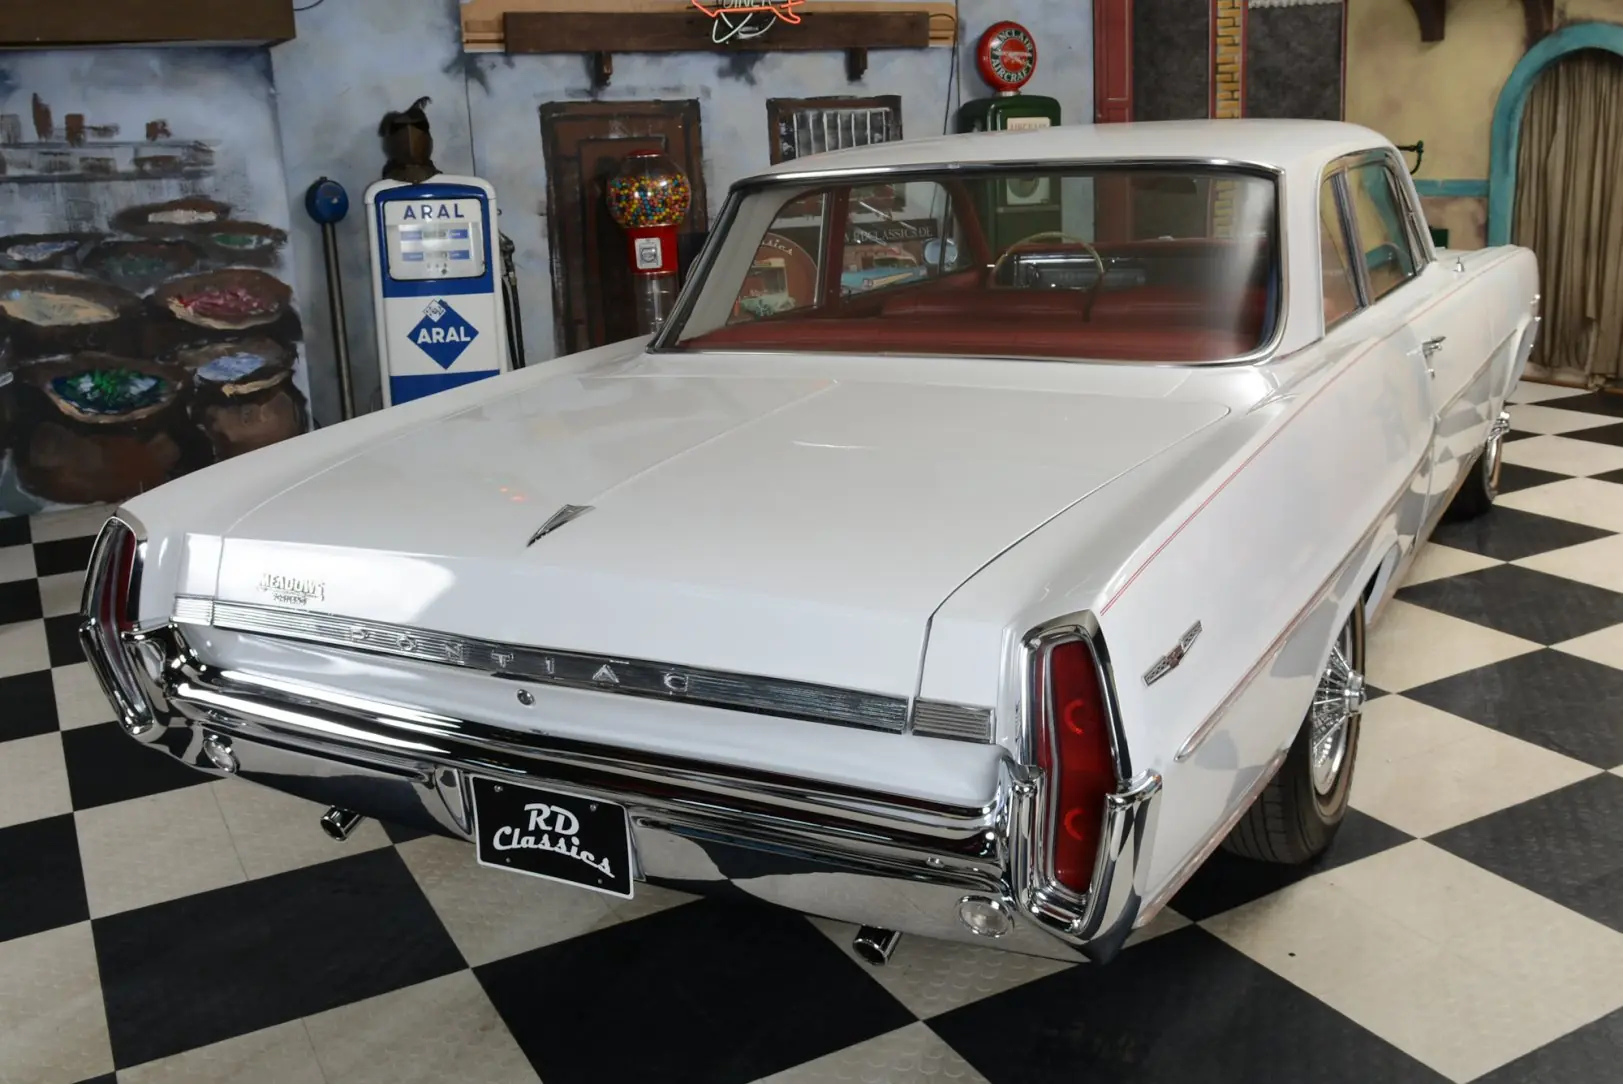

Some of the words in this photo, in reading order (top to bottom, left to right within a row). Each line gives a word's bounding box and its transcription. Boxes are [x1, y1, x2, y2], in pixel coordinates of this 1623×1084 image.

[990, 29, 1034, 52] NCLAIR
[991, 59, 1033, 82] AIRCRAFT
[403, 203, 465, 220] ARAL
[416, 326, 472, 344] ARAL
[350, 625, 688, 694] PONTIAC
[524, 803, 580, 836] RD
[493, 825, 616, 879] Classics
